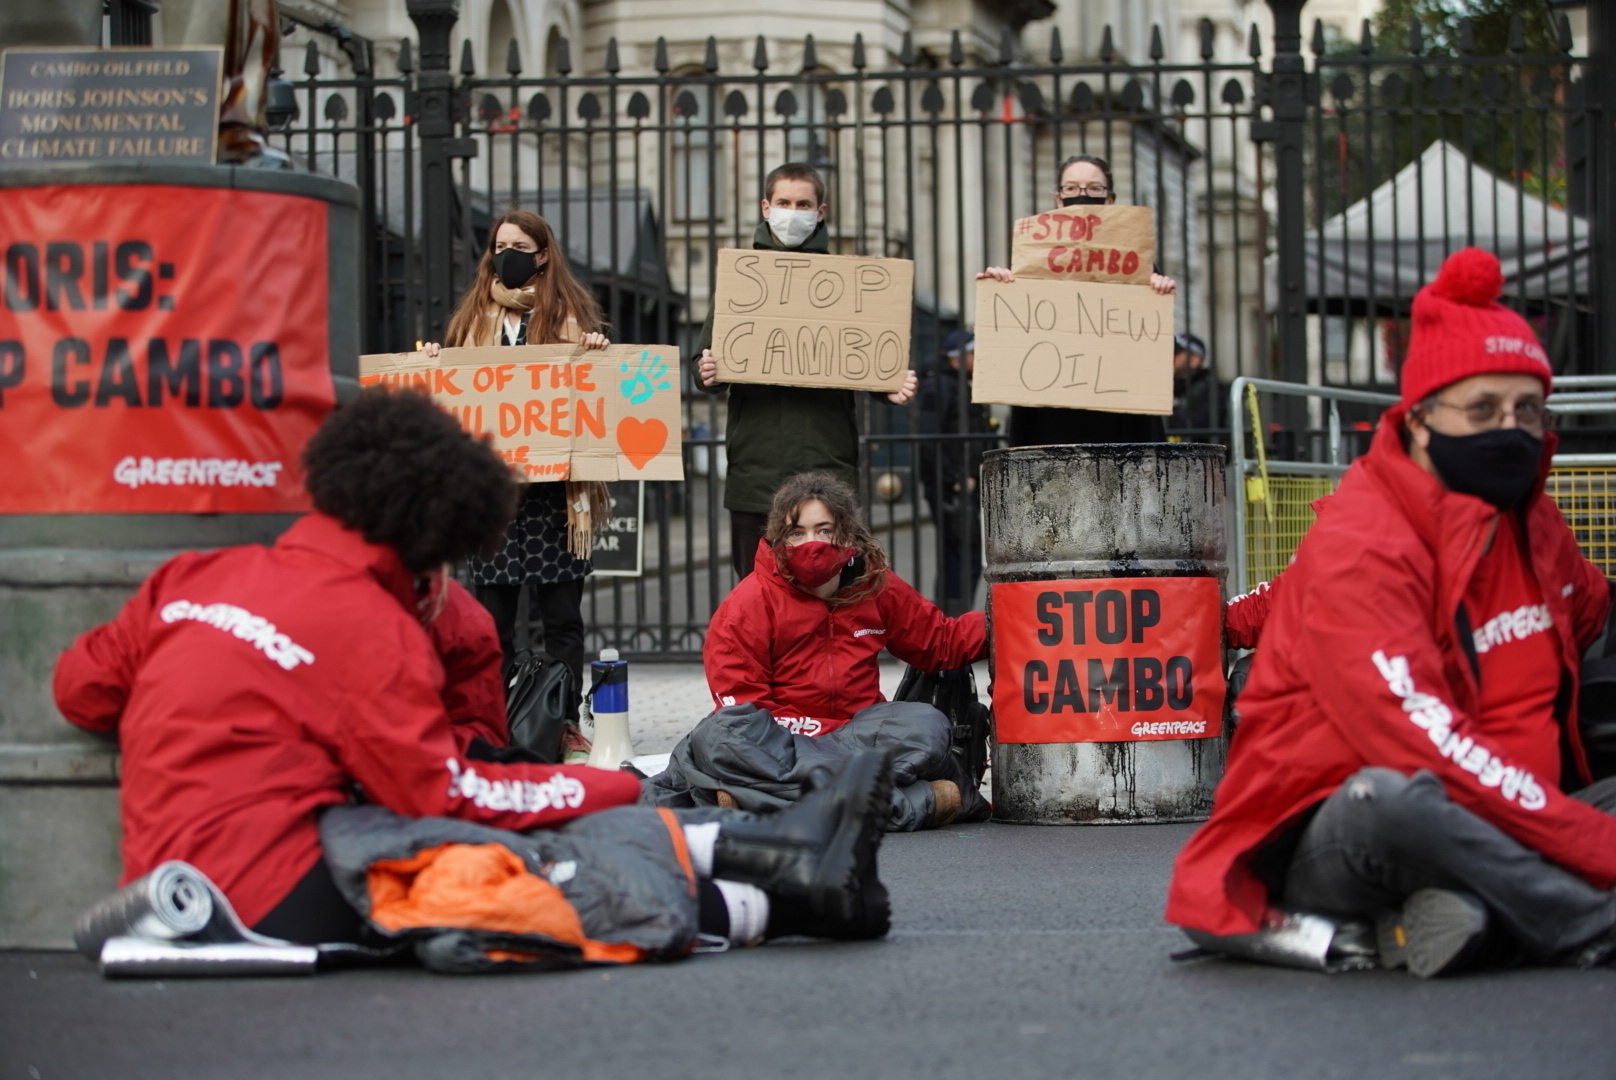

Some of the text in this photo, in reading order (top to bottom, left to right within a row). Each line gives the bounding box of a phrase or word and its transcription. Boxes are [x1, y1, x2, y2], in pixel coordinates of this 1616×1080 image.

[30, 59, 191, 78] CAMBO OILFIELD
[8, 87, 209, 109] BORIS JOHNSON'S
[20, 113, 187, 134] MONUMENTAL
[1, 136, 205, 159] CLIMATE FAILURE
[1017, 213, 1102, 242] #STOP
[1047, 246, 1139, 275] CAMBO
[728, 255, 891, 313] STOP
[993, 291, 1162, 342] NO NEW
[722, 321, 903, 380] CAMBO
[1484, 336, 1523, 355] STOP
[51, 338, 284, 411] CAMBO
[473, 364, 518, 393] OF
[525, 363, 597, 392] THE
[1020, 341, 1129, 394] OIL
[113, 456, 283, 489] GREENPEACE
[1036, 589, 1161, 647] STOP
[1023, 655, 1193, 715] CAMBO
[1131, 720, 1207, 737] GREENPEACE
